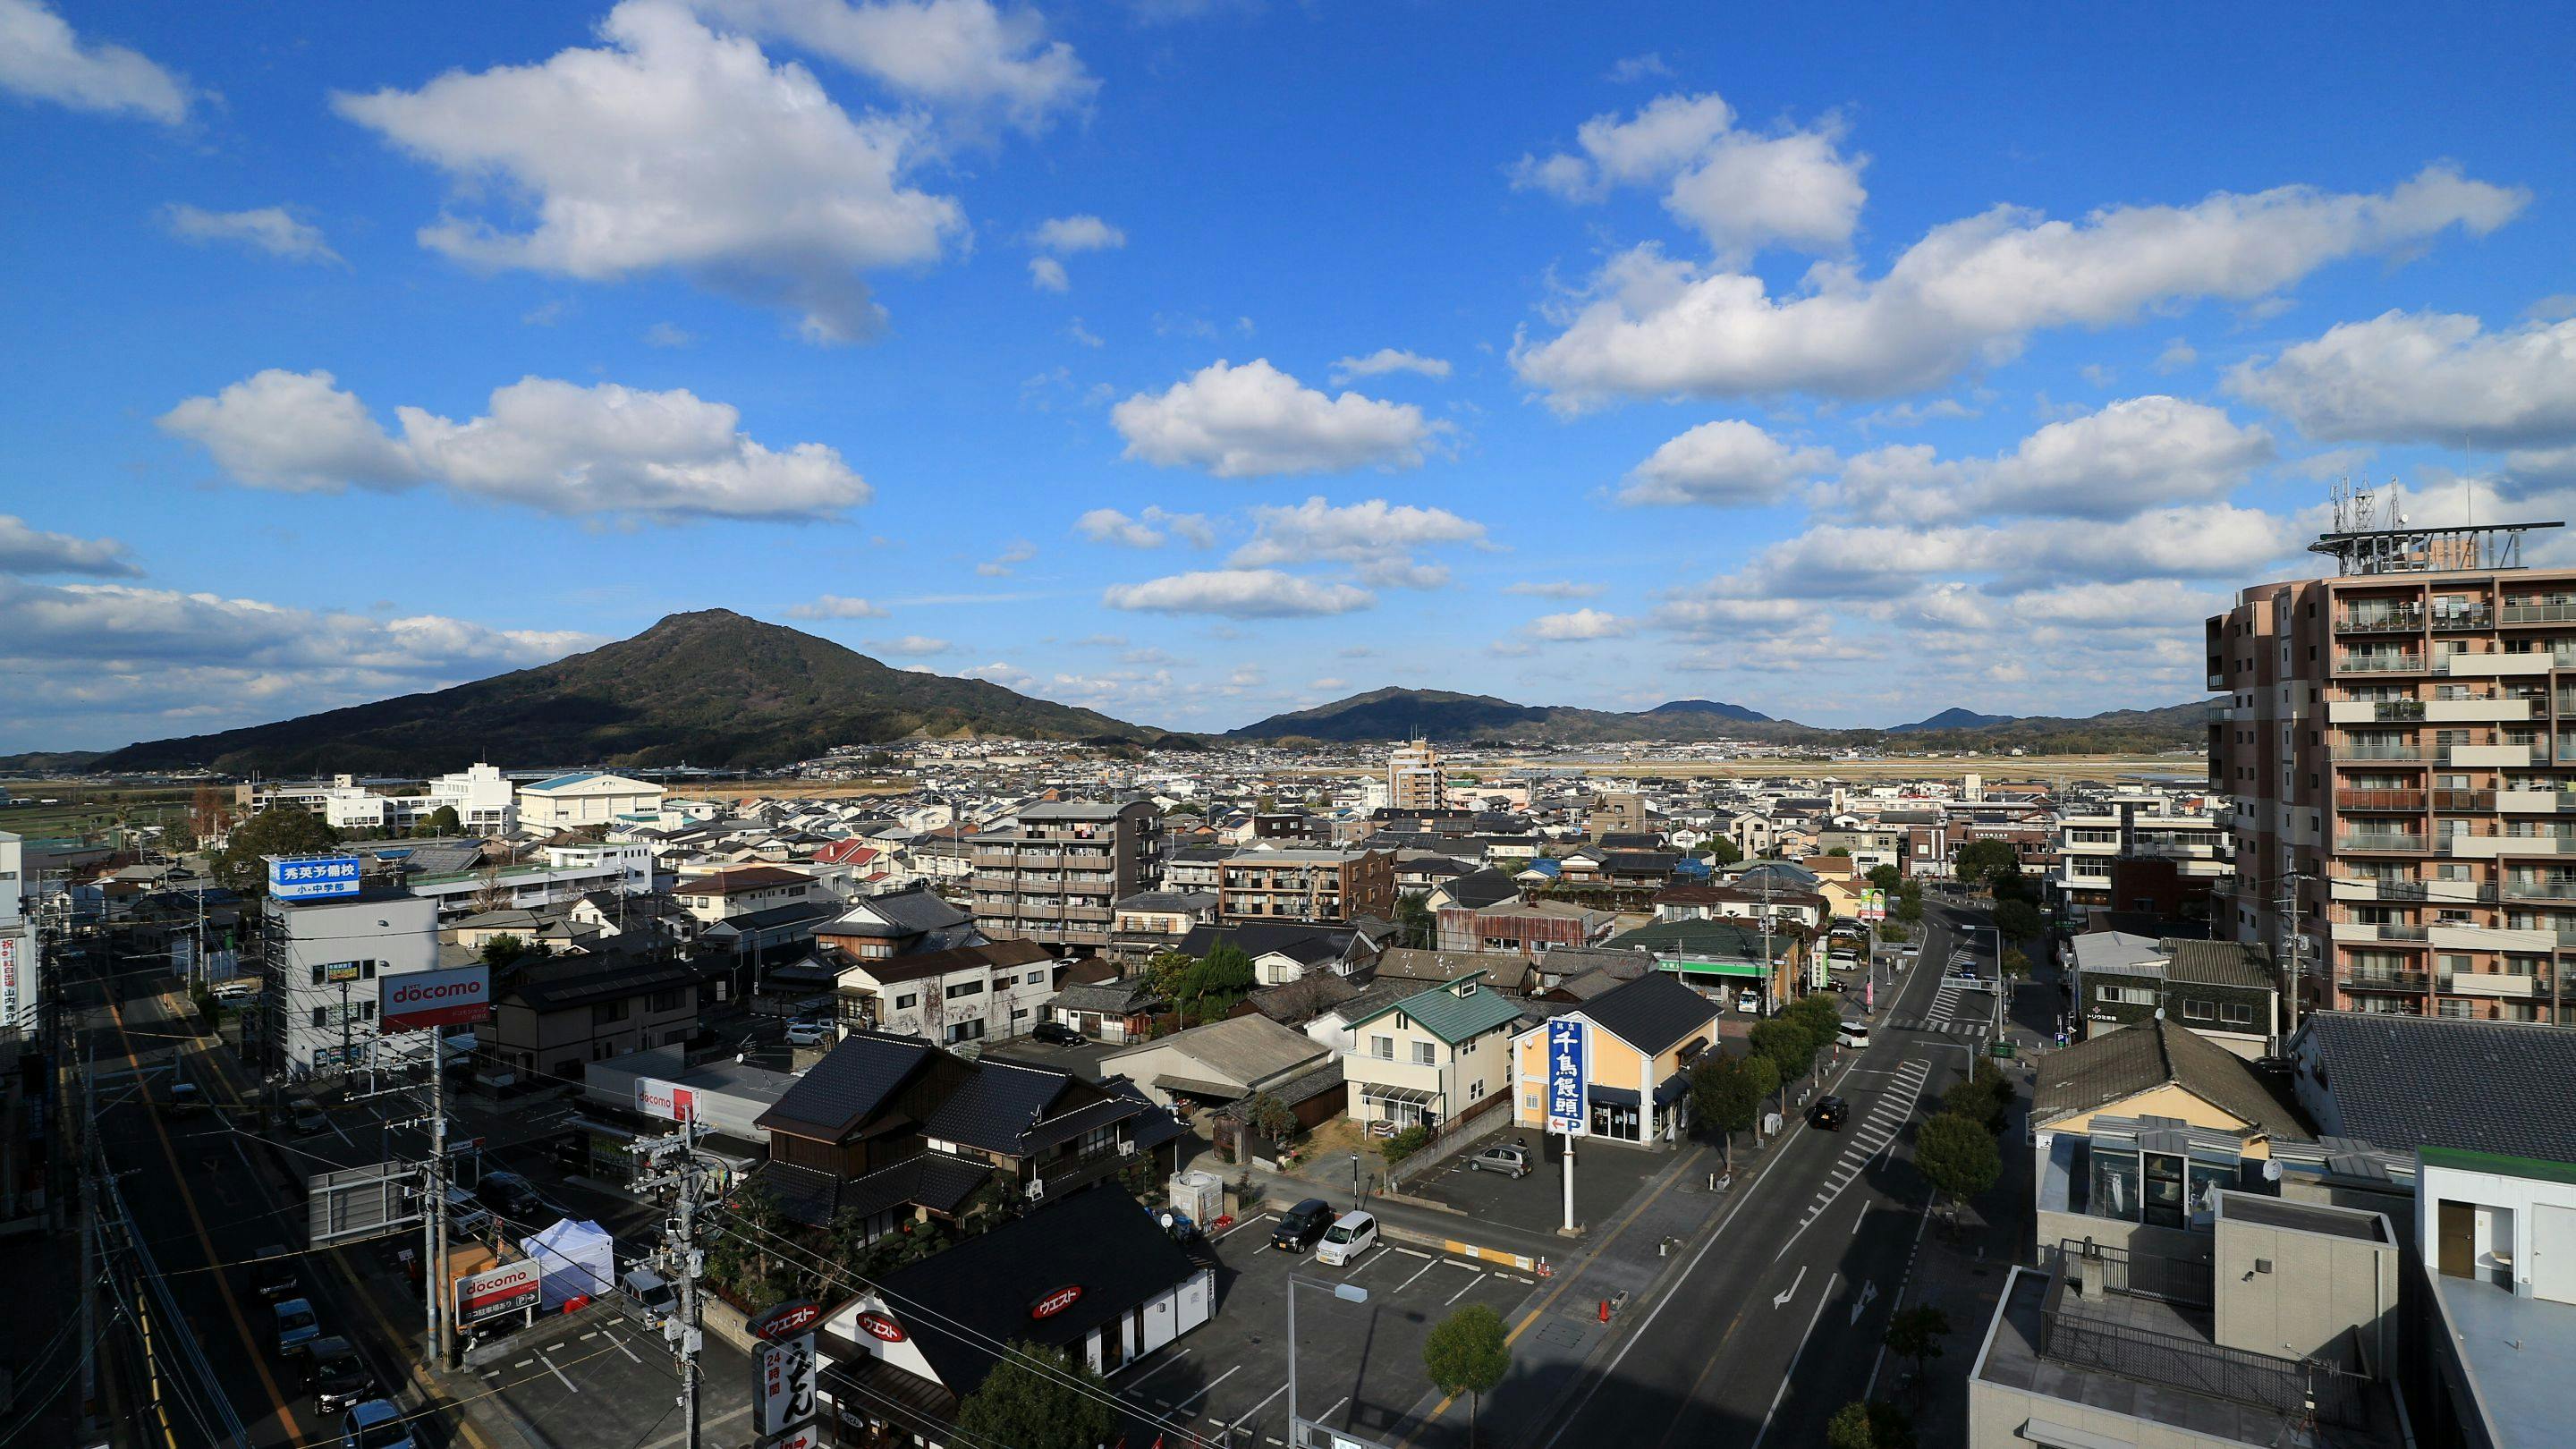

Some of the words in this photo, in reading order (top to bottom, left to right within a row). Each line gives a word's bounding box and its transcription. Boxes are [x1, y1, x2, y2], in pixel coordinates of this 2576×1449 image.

[284, 863, 355, 880] 秀英予備校
[2, 939, 14, 949] 祝
[394, 981, 480, 1003] docomo
[1553, 1031, 1579, 1117] 千鳥饅頭
[639, 1089, 671, 1107] docomo
[1567, 1120, 1580, 1131] P
[466, 1272, 526, 1295] docomo
[1039, 1290, 1076, 1315] ウエスト
[765, 1309, 814, 1335] ウエスト
[863, 1317, 898, 1339] ウエスト
[767, 1352, 780, 1397] 24時間
[783, 1342, 814, 1424] うどん
